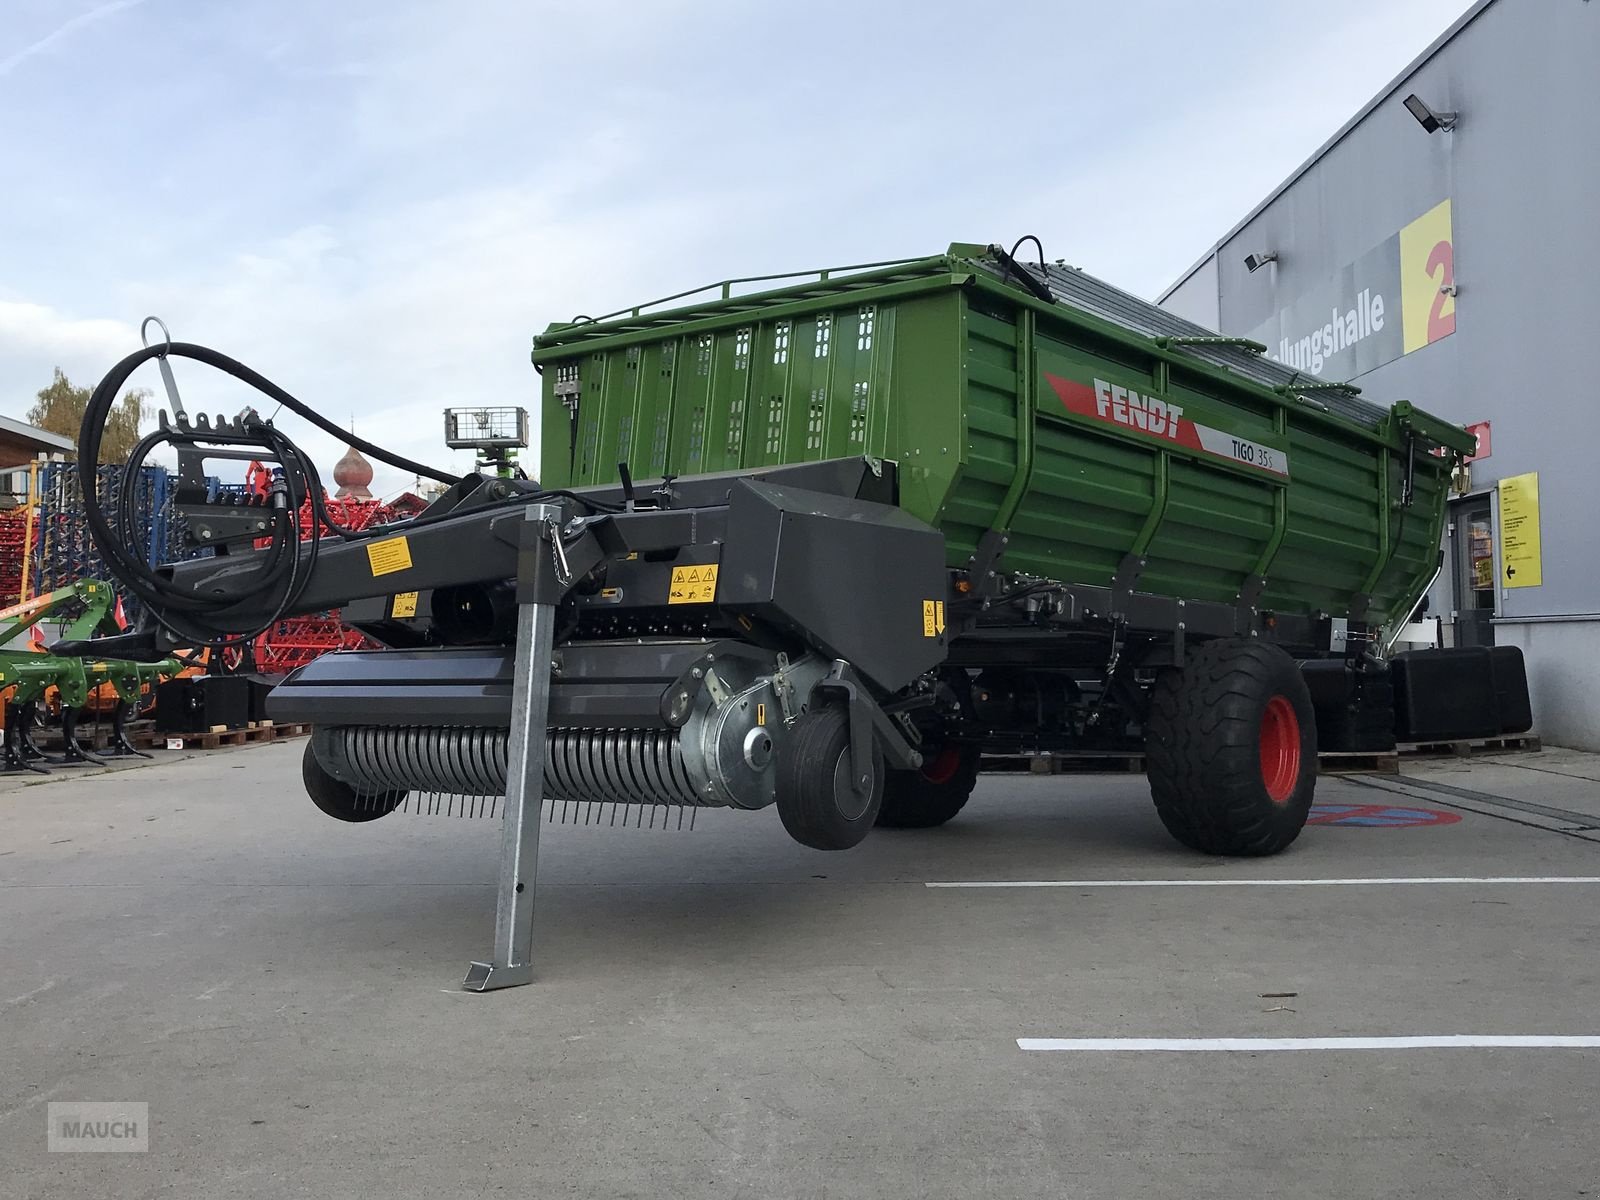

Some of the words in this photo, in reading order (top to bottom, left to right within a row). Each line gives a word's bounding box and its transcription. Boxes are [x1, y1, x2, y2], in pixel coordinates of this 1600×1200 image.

[1425, 240, 1457, 345] 2
[1093, 378, 1184, 439] FENDT
[1231, 439, 1254, 462] TIGO
